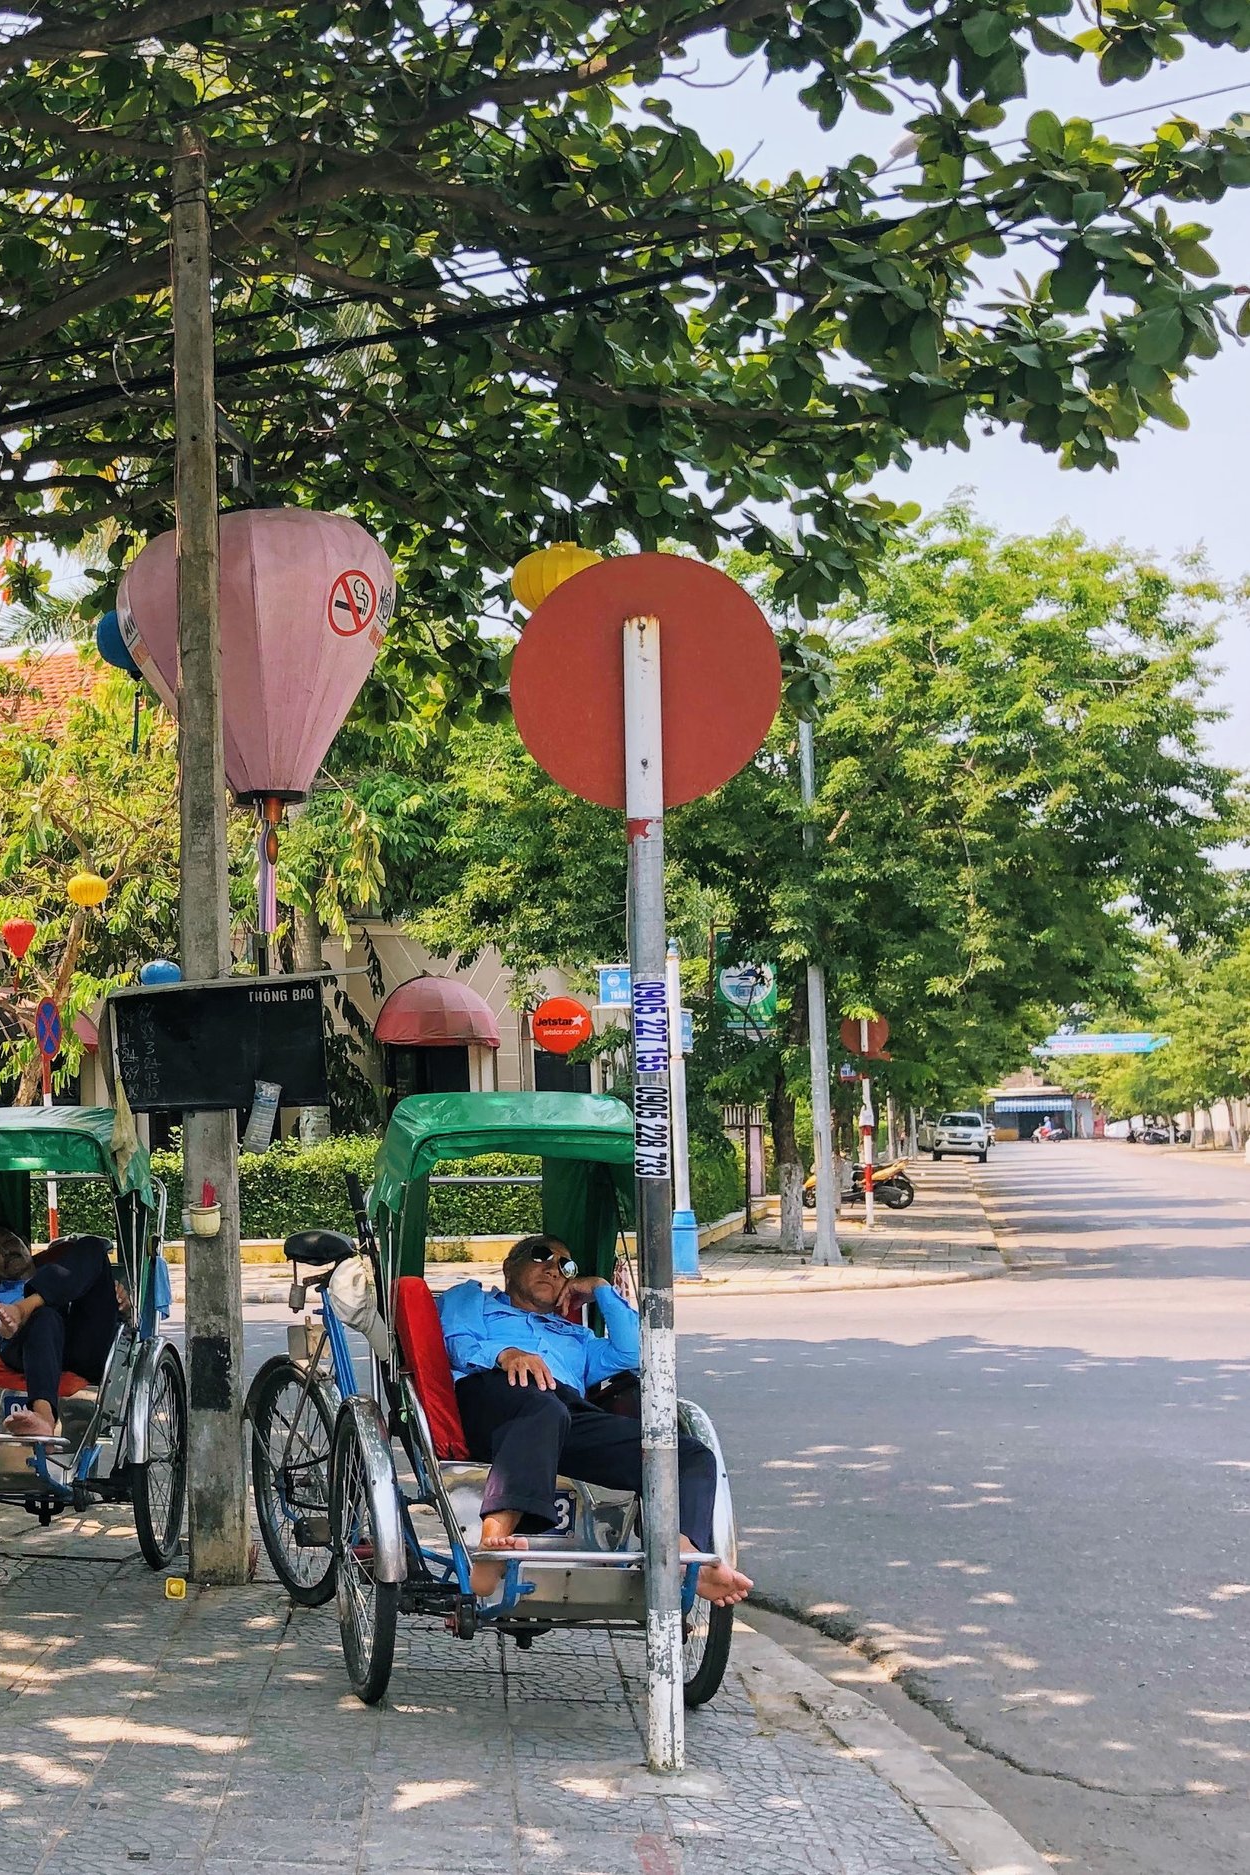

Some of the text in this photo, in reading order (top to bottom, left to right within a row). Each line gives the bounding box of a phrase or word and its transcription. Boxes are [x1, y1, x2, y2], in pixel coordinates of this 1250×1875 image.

[535, 1017, 574, 1027] Jetstar
[542, 1029, 581, 1037] jetstar.com
[633, 981, 669, 1072] 0905.227.155
[635, 1086, 668, 1176] 0905.228.733
